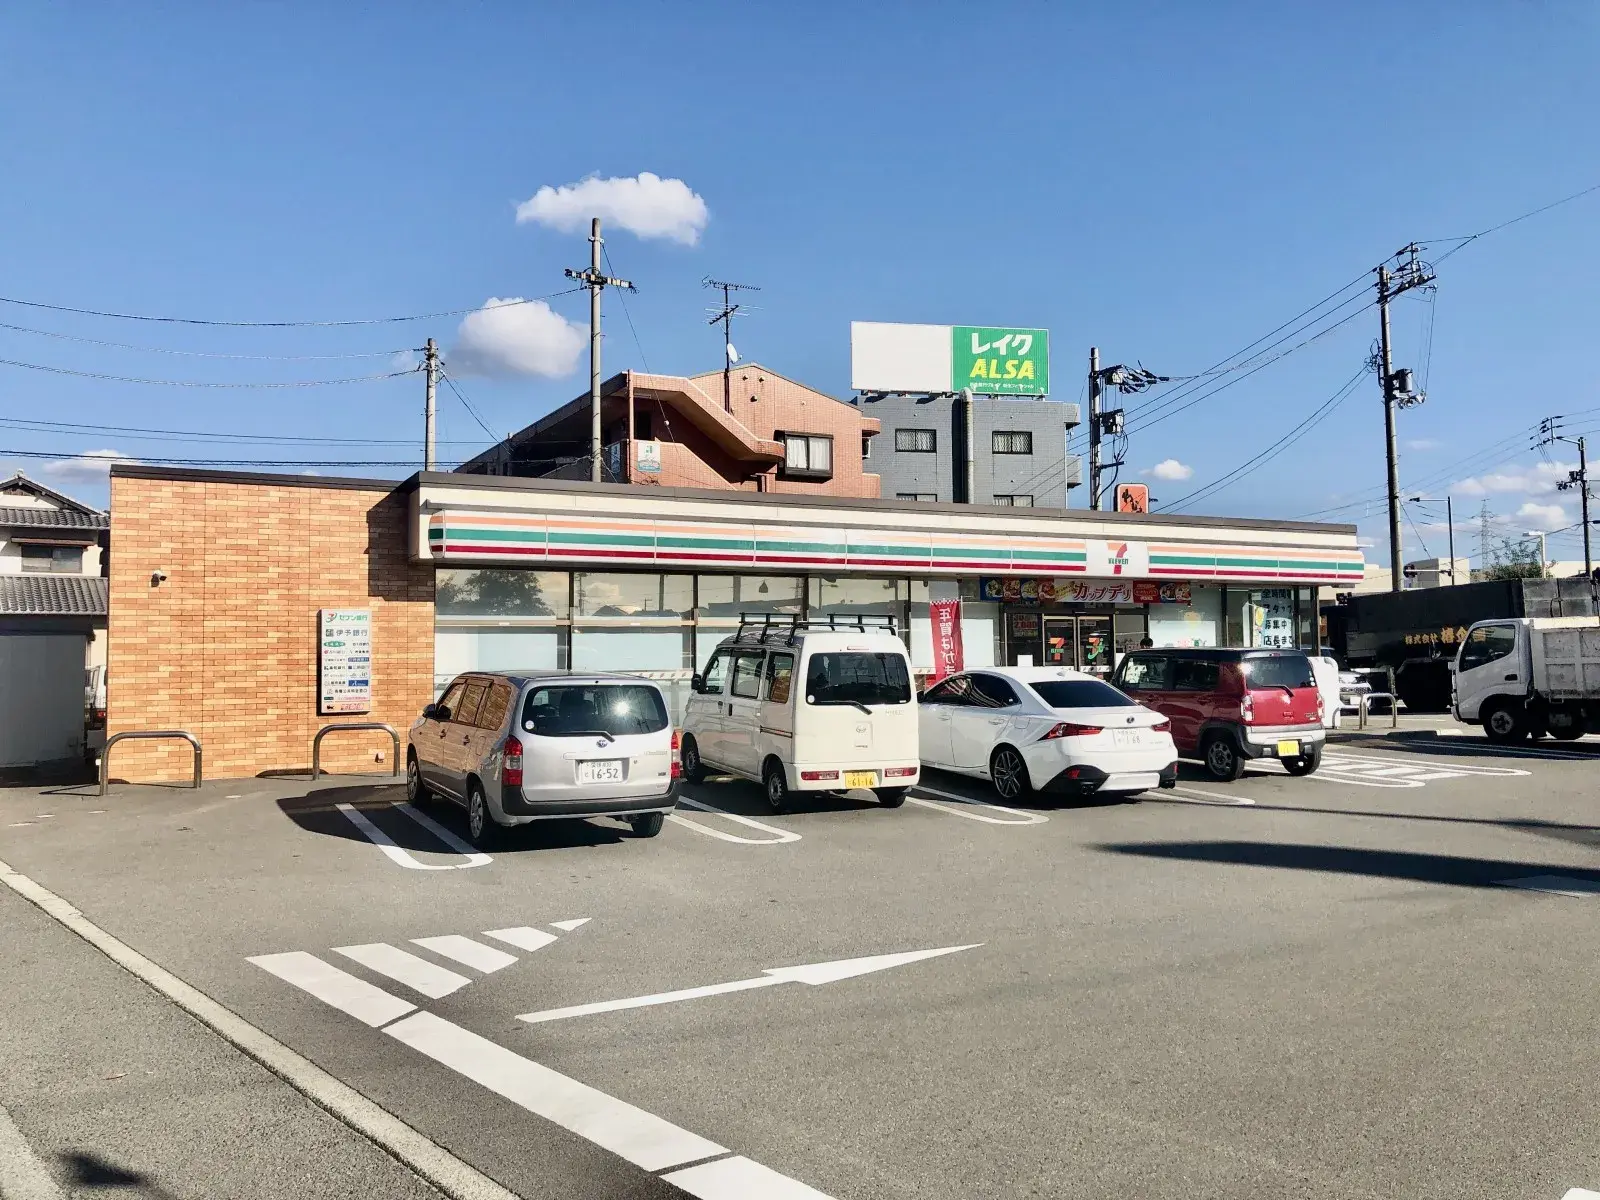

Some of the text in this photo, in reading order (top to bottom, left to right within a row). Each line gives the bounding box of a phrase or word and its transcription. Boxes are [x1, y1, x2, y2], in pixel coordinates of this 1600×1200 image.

[972, 333, 1032, 355] レイク
[969, 358, 1034, 380] ALSA
[1073, 582, 1131, 601] カップデリ
[336, 629, 368, 637] 伊予銀行
[591, 768, 619, 780] 16-52
